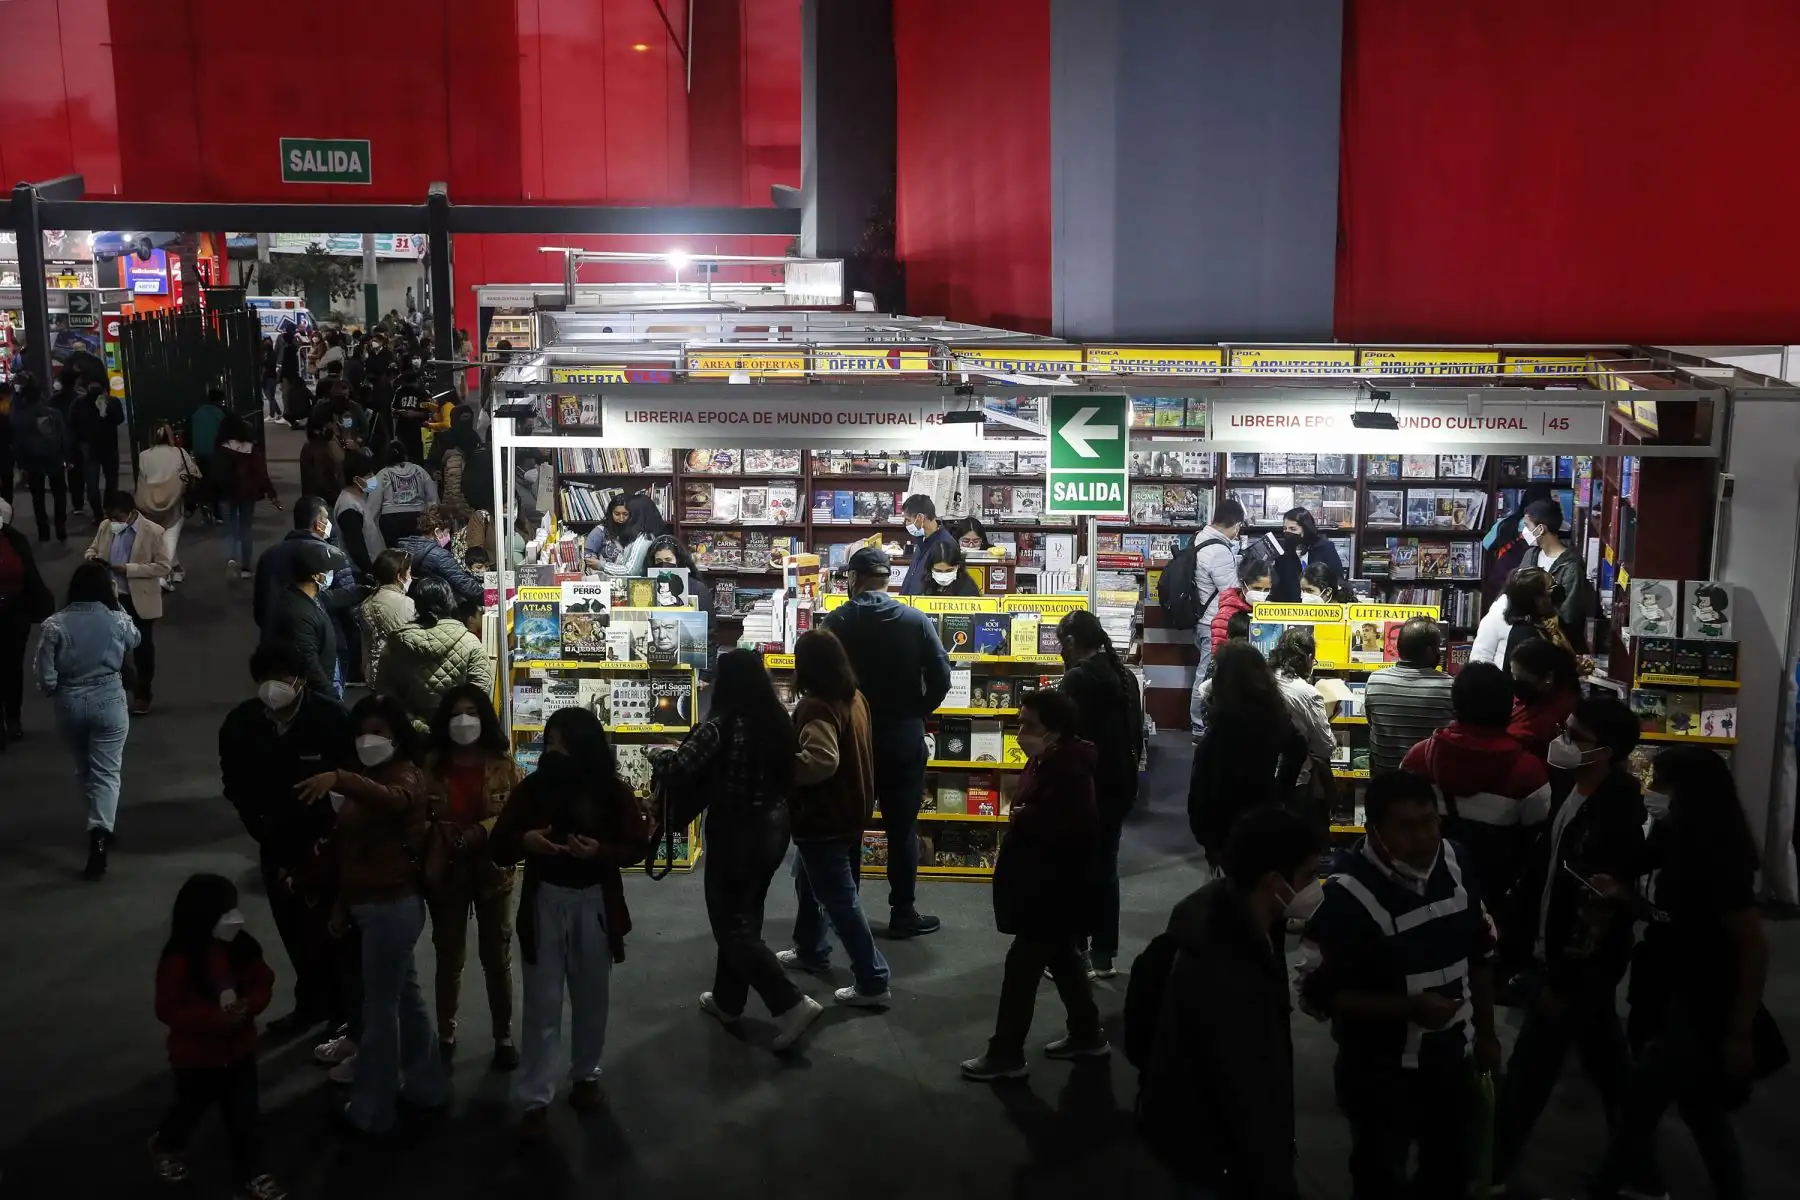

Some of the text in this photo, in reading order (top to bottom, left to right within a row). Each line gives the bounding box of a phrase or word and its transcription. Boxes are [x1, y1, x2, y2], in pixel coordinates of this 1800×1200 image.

[290, 149, 363, 173] SALIDA
[396, 238, 409, 248] 31
[703, 358, 727, 369] AREA
[751, 358, 800, 369] OFERTAS
[828, 358, 886, 370] OFERTA
[1111, 359, 1217, 373] ENCICLOPEDIAS
[1251, 360, 1351, 373] ARQUITECTURA
[1380, 361, 1425, 374] DIBUJO
[1439, 362, 1496, 374] PINTURA
[625, 411, 945, 426] LIBRERIA EPOCA DE MUNDO CULTURAL 45
[1231, 415, 1301, 428] LIBRERIA
[1396, 416, 1442, 429] UNDO
[1446, 417, 1528, 430] CULTURAL
[1548, 418, 1570, 430] 45
[1053, 481, 1122, 502] SALIDA
[929, 602, 982, 612] LITERATURA
[1007, 603, 1084, 613] RECOMENDACIONES
[1258, 608, 1340, 618] RECOMENDACIONES
[669, 683, 691, 691] Sagan
